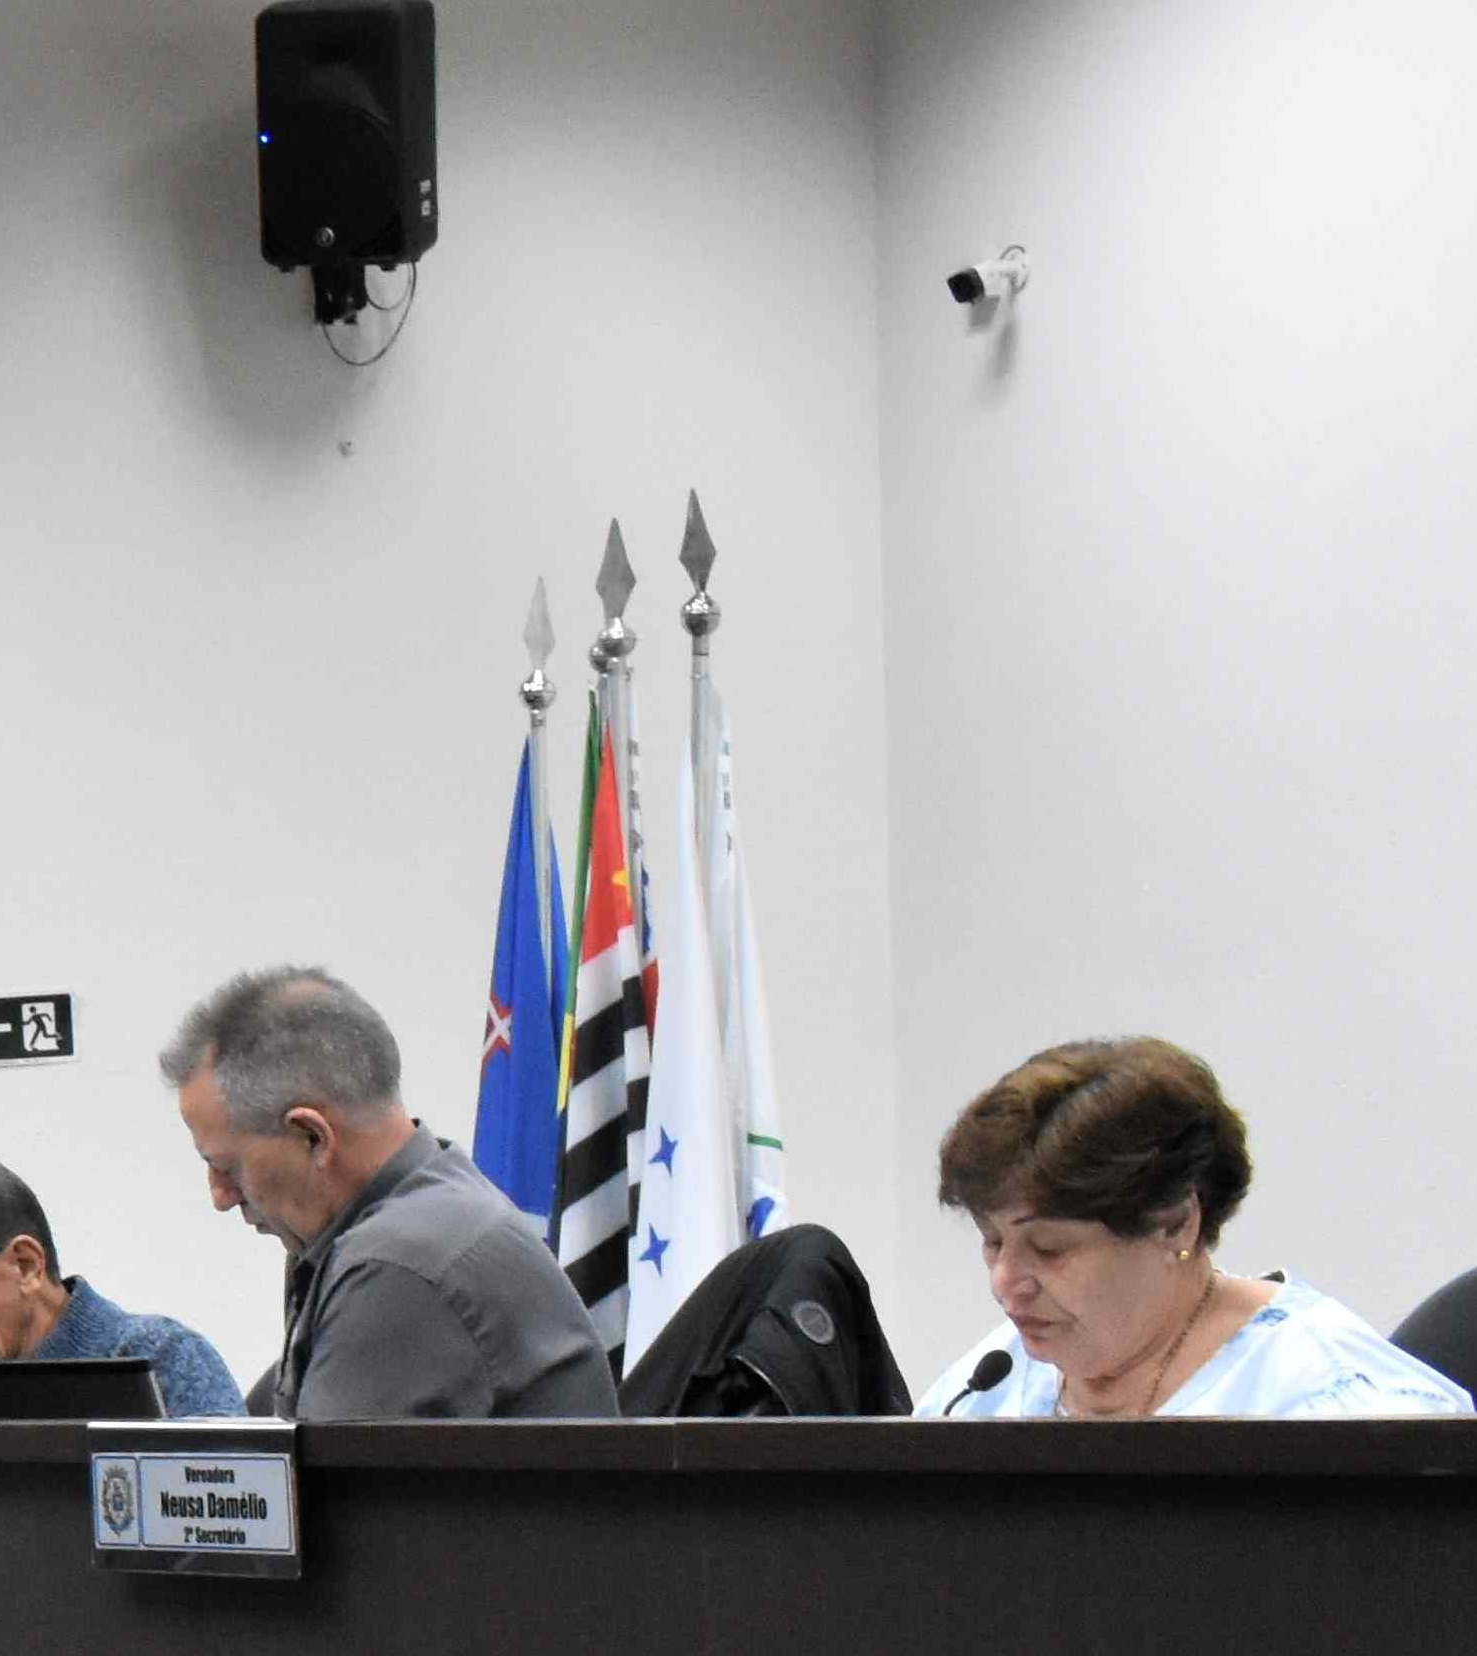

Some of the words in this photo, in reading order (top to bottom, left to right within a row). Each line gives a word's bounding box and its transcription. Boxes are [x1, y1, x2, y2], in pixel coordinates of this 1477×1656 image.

[184, 1465, 235, 1484] Vereadora
[160, 1490, 204, 1518] Neusa
[207, 1490, 268, 1520] Damélio
